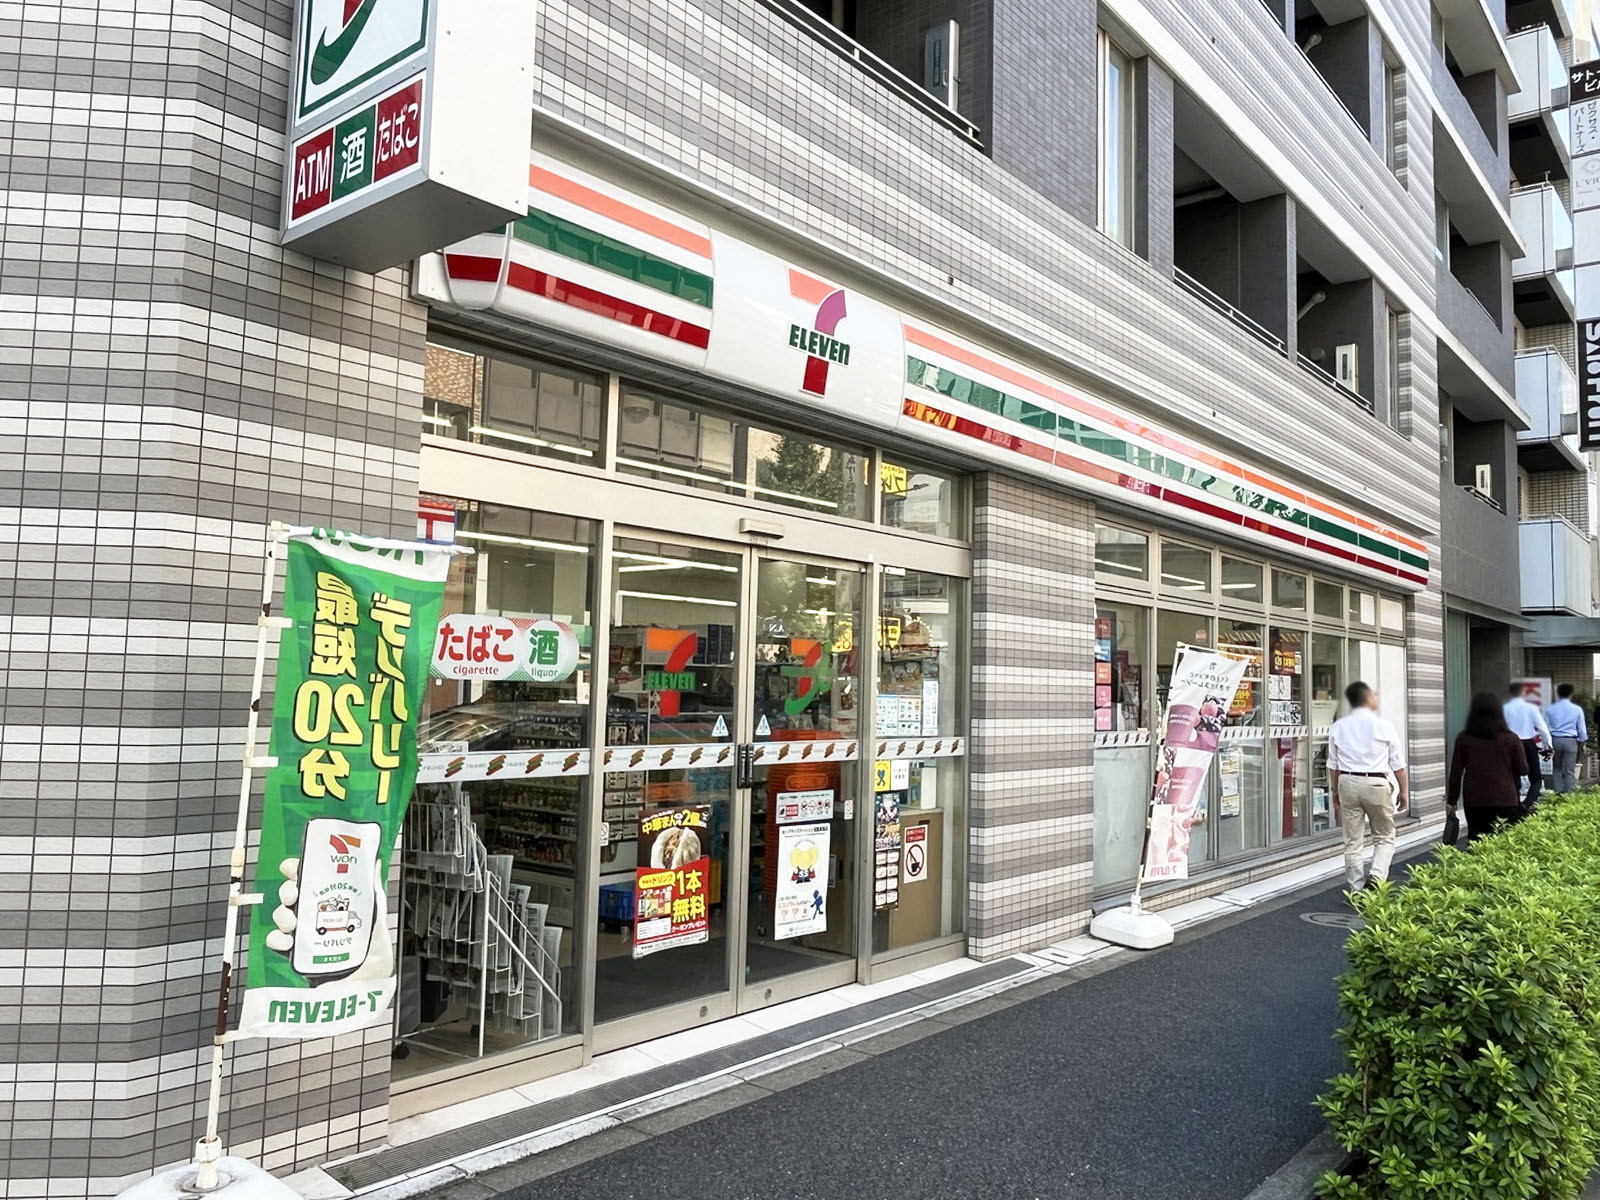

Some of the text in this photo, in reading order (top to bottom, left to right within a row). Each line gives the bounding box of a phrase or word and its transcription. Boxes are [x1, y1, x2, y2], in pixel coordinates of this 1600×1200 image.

[1571, 69, 1600, 83] サト
[295, 103, 419, 204] ATM 酒 たばこ
[438, 622, 560, 666] たばこ 酒
[453, 664, 559, 677] cigarette liquor
[677, 869, 703, 896] 1本
[673, 893, 706, 924] 無料
